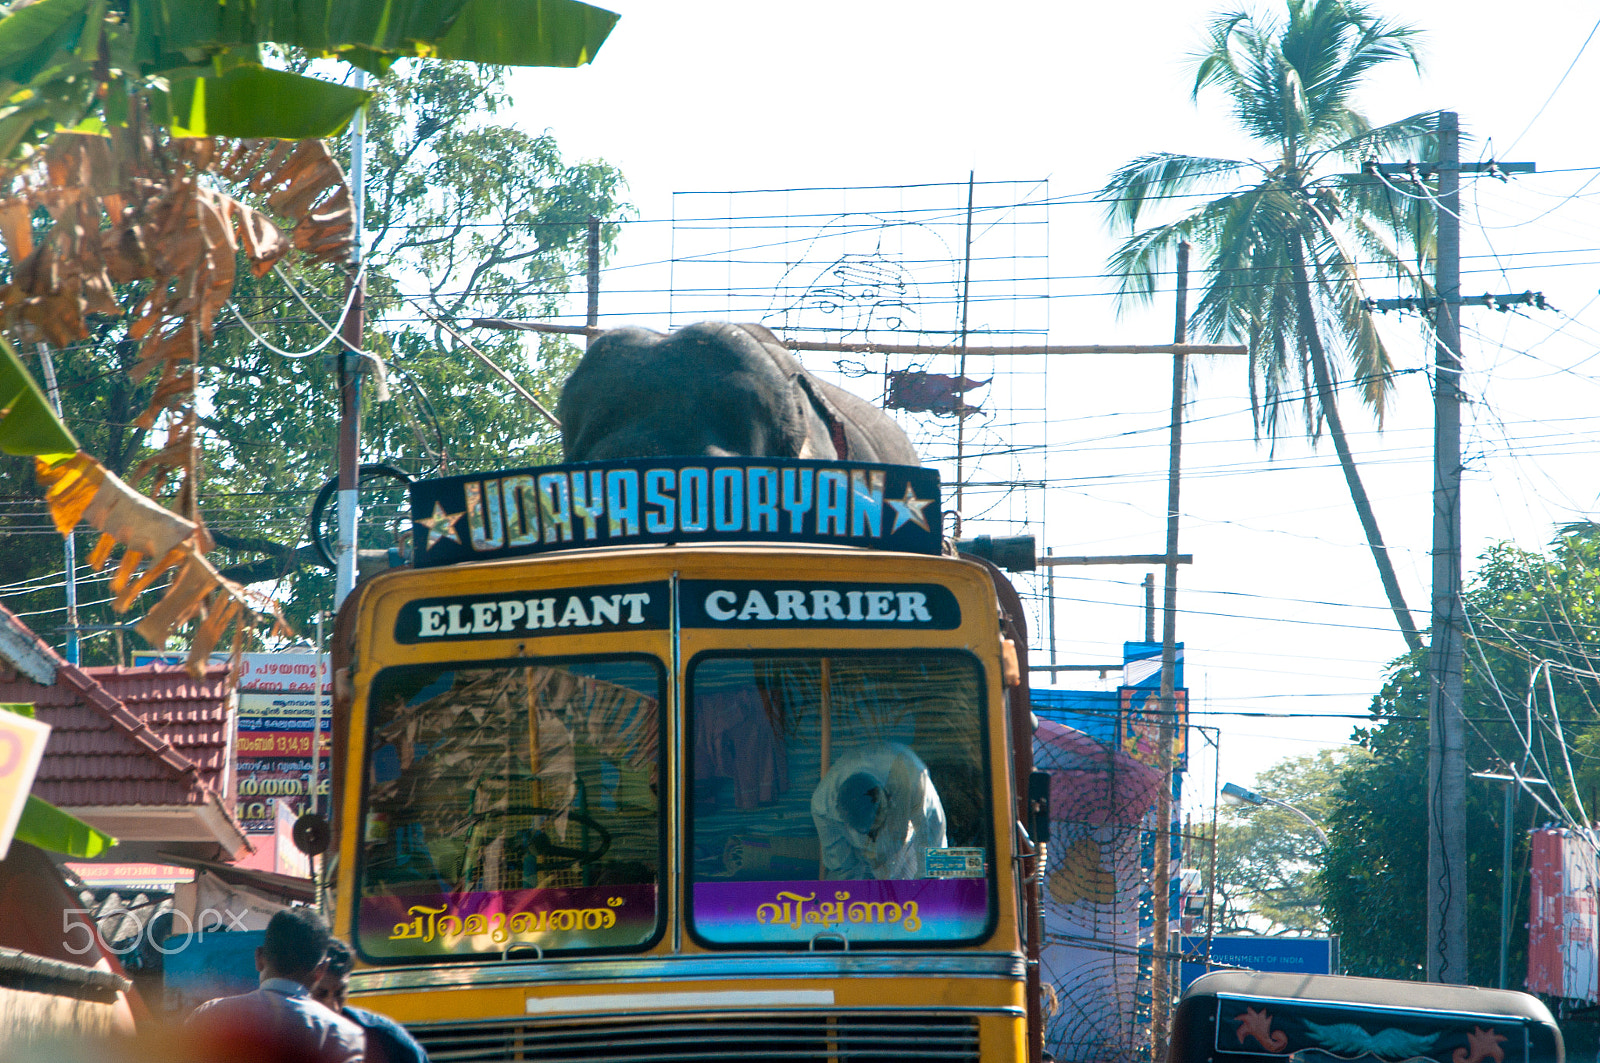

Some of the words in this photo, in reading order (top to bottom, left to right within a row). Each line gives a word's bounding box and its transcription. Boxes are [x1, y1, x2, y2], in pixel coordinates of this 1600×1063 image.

[463, 466, 887, 551] UDAYASOORYAN
[417, 593, 650, 638] ELEPHANT
[704, 590, 933, 622] CARRIER
[236, 734, 275, 751] സംബർ
[276, 737, 310, 754] 13,14,19
[756, 890, 922, 932] വിഷ്ണു
[1210, 953, 1265, 964] OVERNMENT
[1266, 955, 1278, 964] OF
[1279, 956, 1305, 965] INDIA
